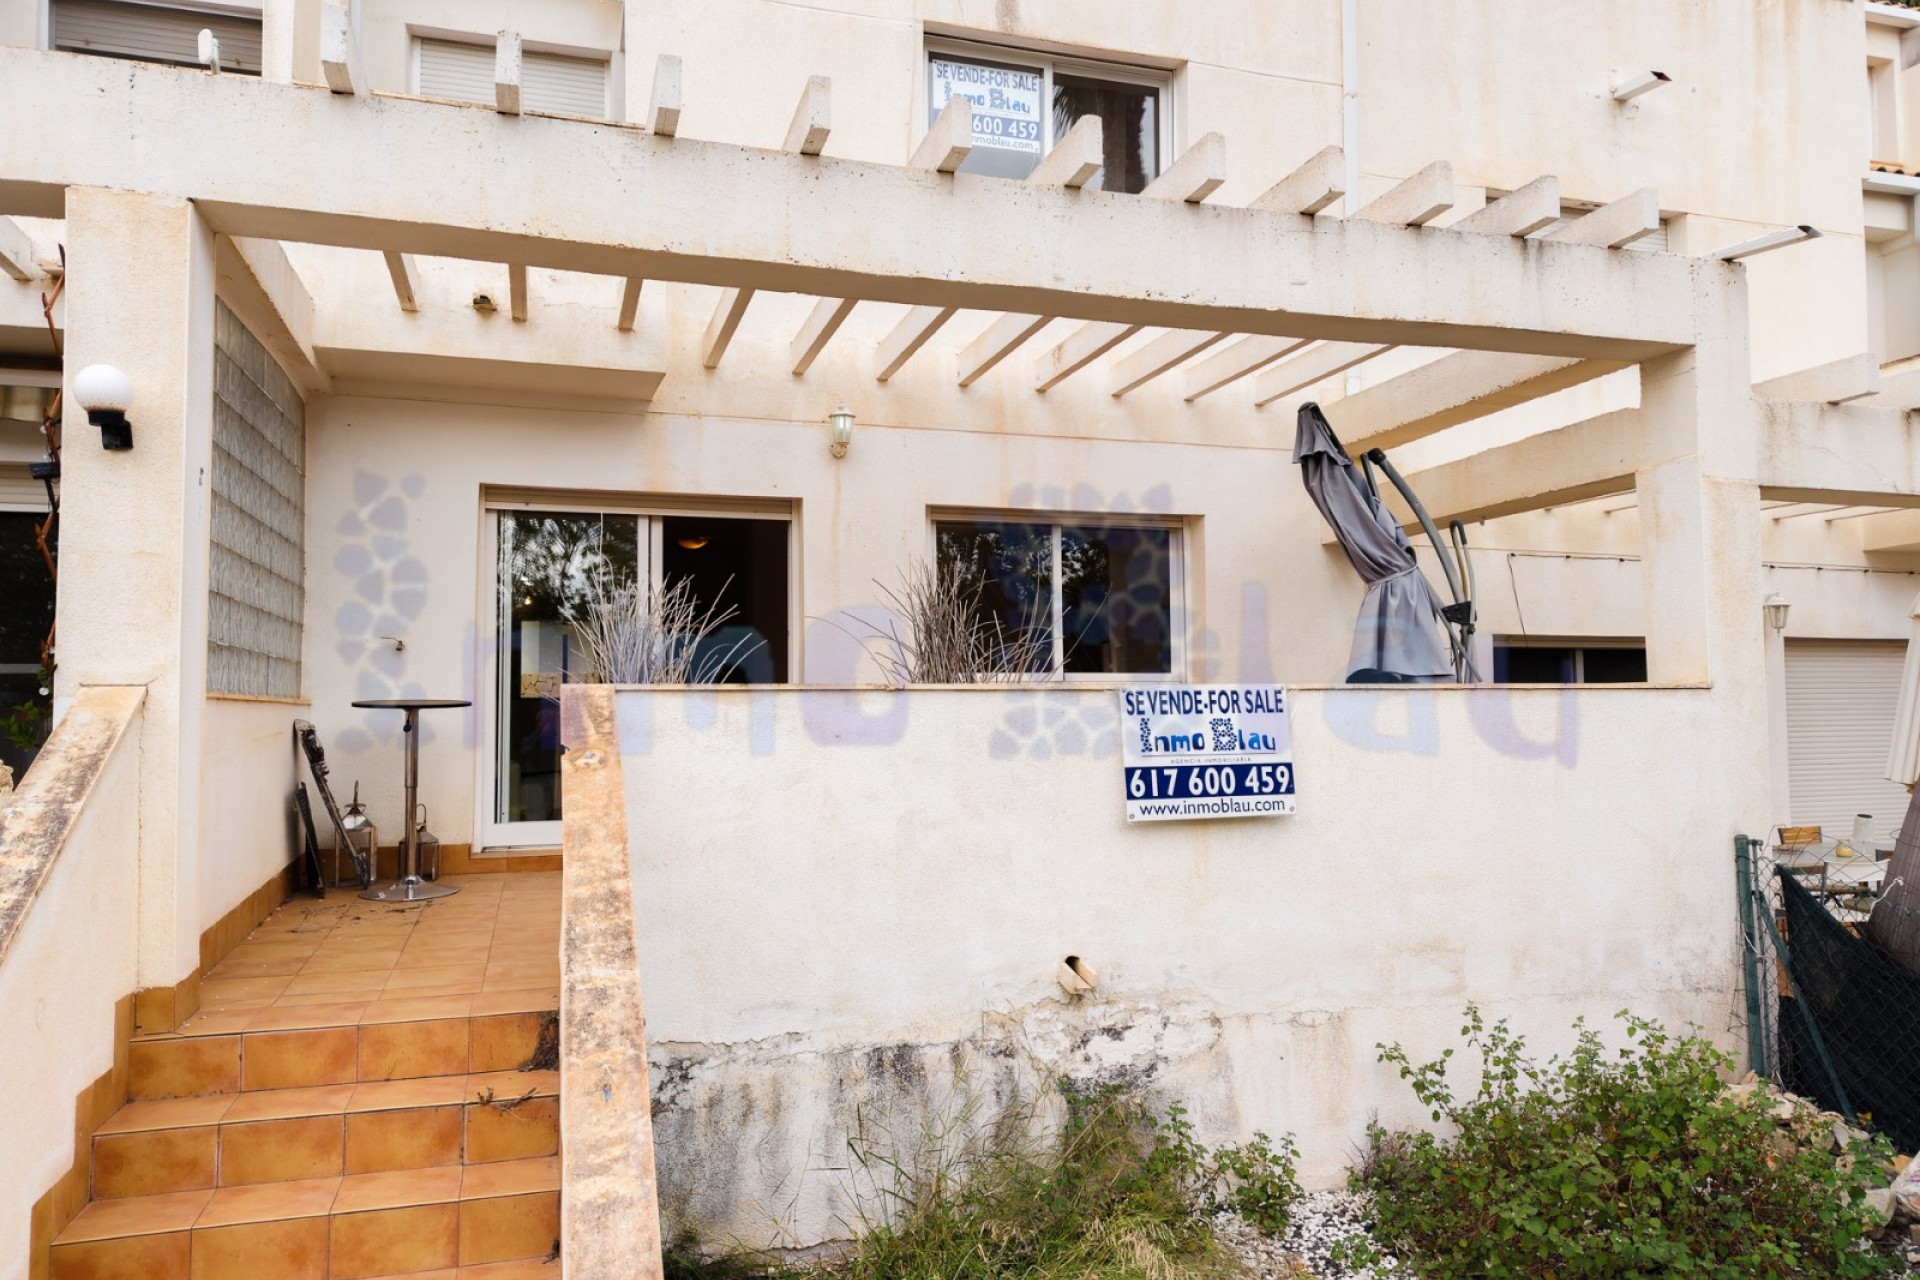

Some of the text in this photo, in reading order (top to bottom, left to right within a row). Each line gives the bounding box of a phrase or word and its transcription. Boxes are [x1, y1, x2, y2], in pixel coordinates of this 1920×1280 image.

[937, 63, 949, 79] SE
[1012, 73, 1038, 92] SALE
[988, 87, 1031, 114] Blau
[972, 115, 1003, 135] 600
[1008, 120, 1038, 140] 459
[1126, 690, 1146, 716] SE
[1245, 689, 1284, 714] SALE
[1139, 717, 1277, 753] Inmo Blau
[1130, 765, 1290, 798] 617 600 459
[1139, 798, 1285, 816] www.inmoblau.com
